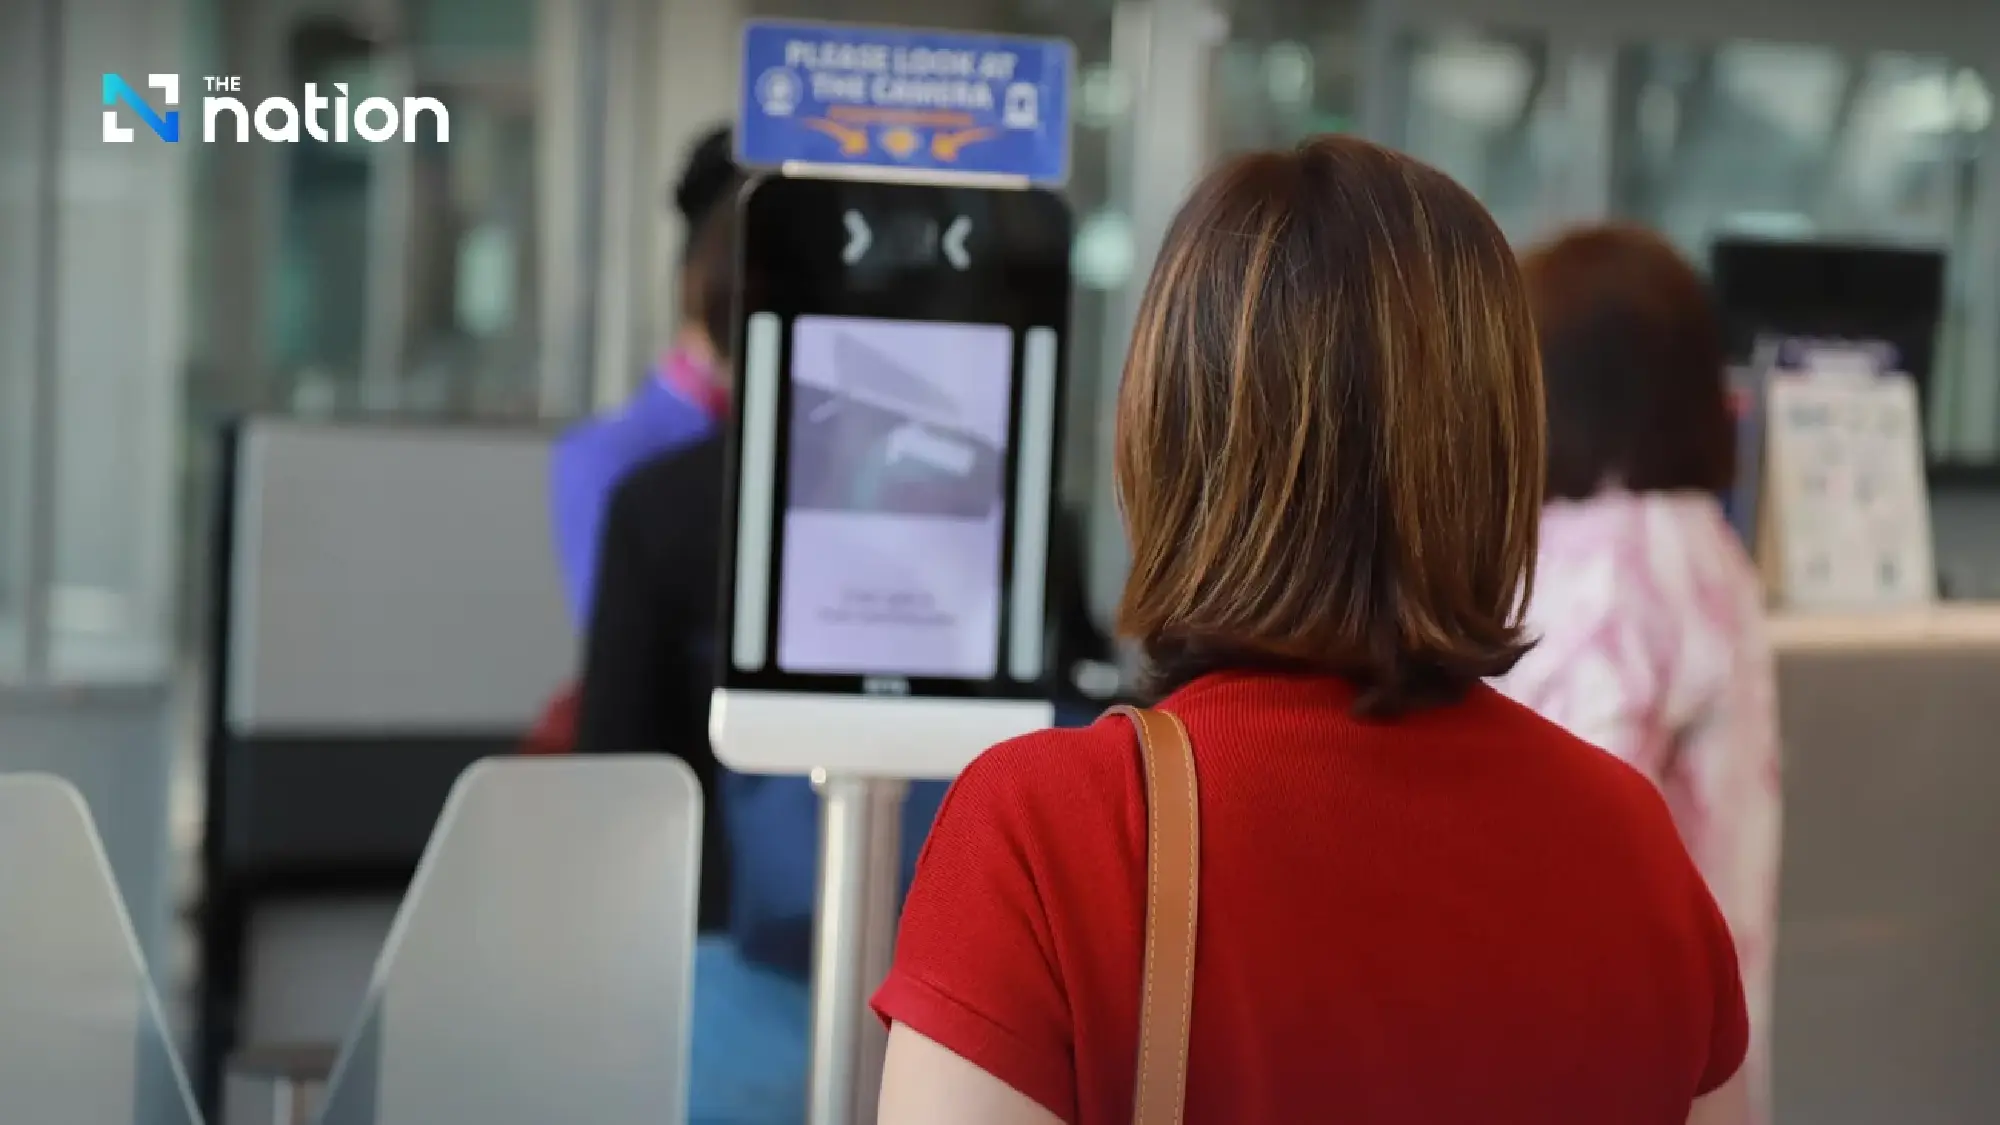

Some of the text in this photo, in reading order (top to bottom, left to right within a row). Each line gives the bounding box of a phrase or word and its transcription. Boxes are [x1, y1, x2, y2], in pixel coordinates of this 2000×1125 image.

[785, 40, 1018, 80] PLEASE LOOK AT
[812, 71, 993, 110] THE CAMERA
